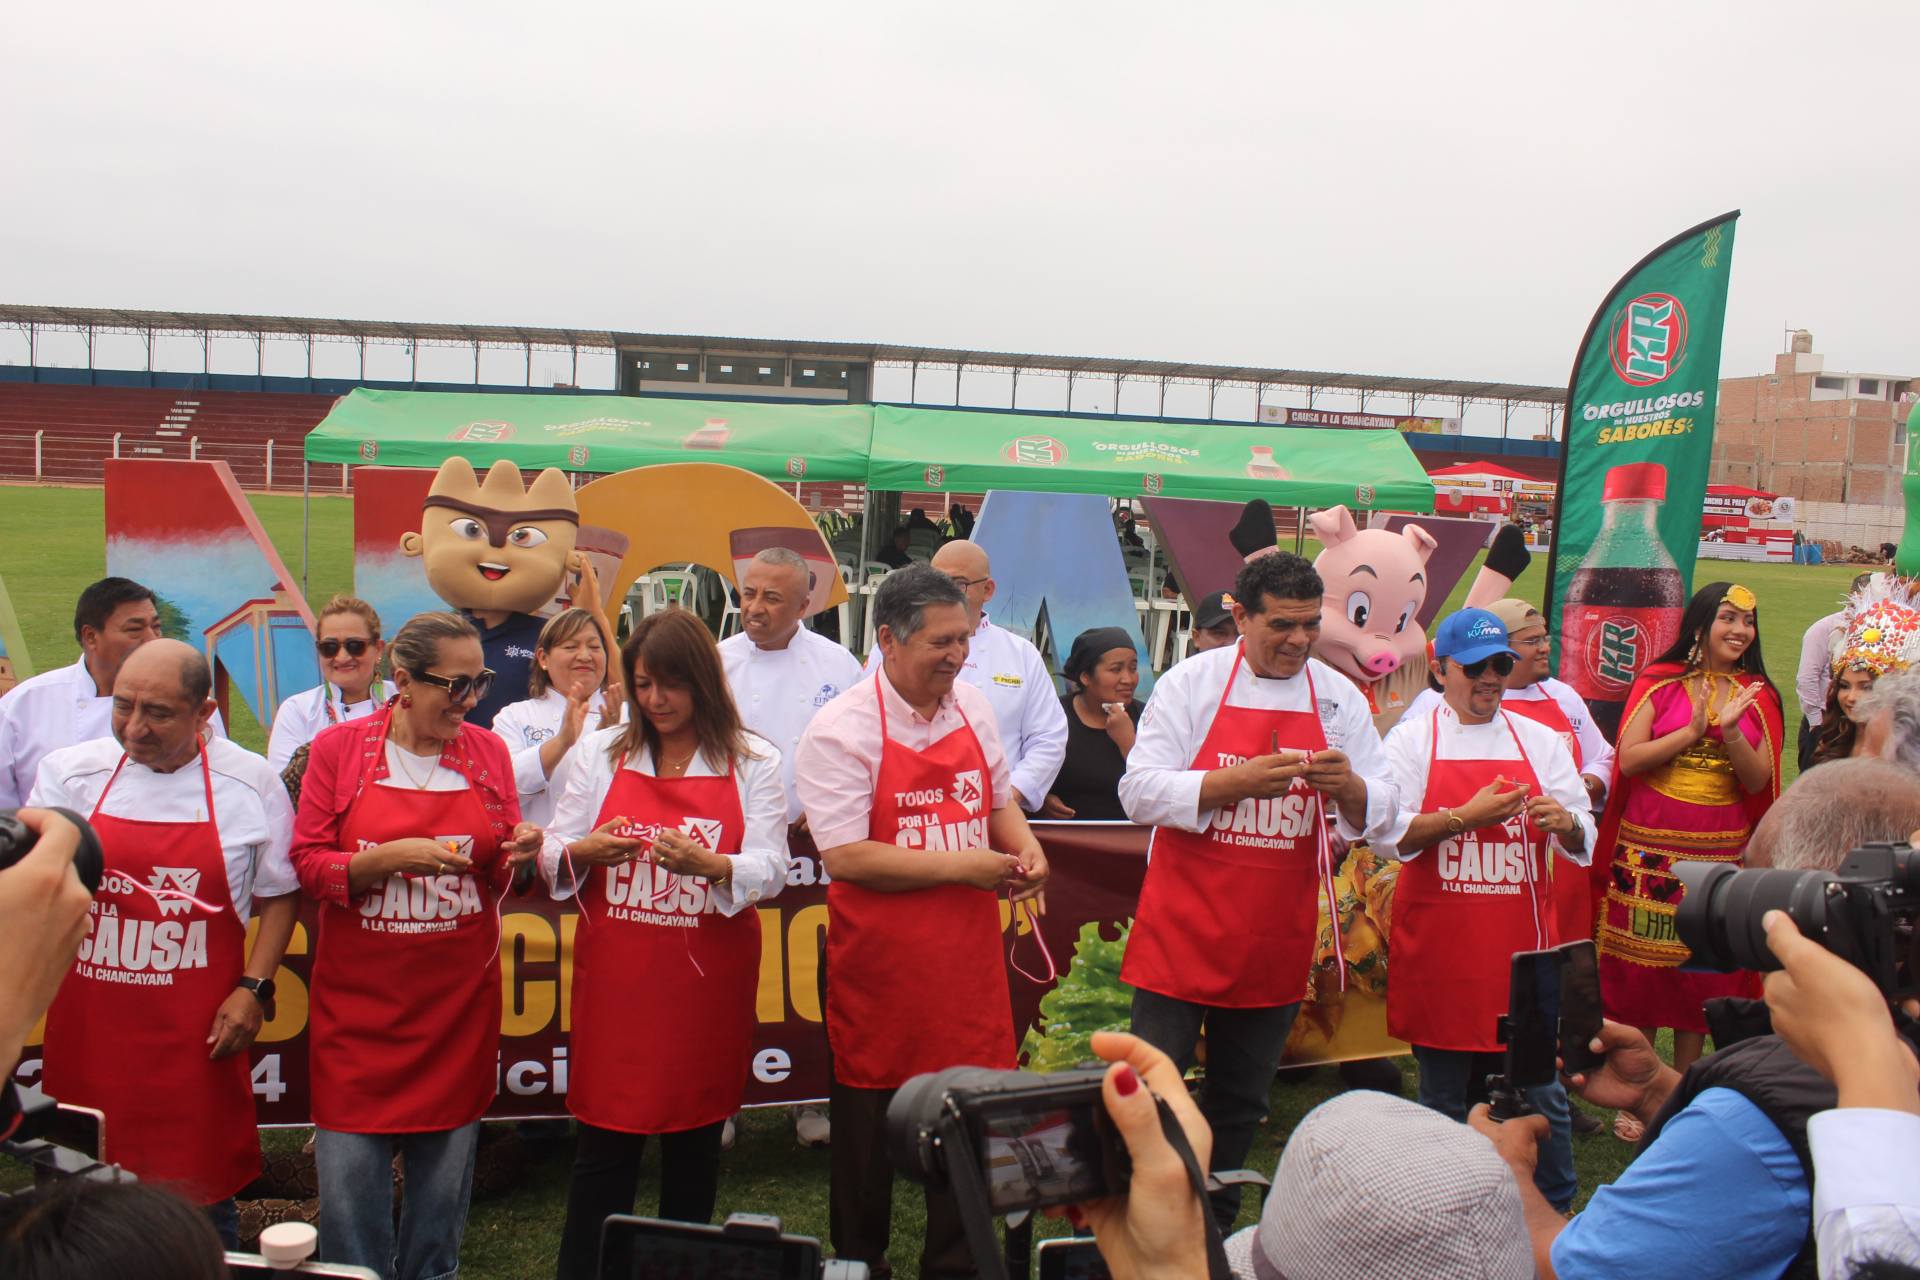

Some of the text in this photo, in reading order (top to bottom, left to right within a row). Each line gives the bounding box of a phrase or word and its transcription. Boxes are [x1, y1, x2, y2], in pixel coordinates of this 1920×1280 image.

[1626, 300, 1674, 380] KR
[1583, 391, 1704, 420] ORGULLOSOS
[1291, 411, 1396, 428] CAUSA A LA CHANCAYANA
[1625, 411, 1671, 424] NUESTROS
[1597, 418, 1688, 444] SABORES
[1598, 621, 1638, 684] KR
[1218, 753, 1248, 768] TOD
[895, 788, 944, 807] TODOS
[898, 813, 940, 829] POR LA
[1212, 794, 1316, 838] CAUSA
[1213, 831, 1295, 849] A LA CHANCAYANA
[1442, 881, 1521, 895] A LA CHANCAYANA
[102, 901, 118, 917] LA
[607, 906, 699, 928] A LA CHANCAYANA
[362, 919, 457, 934] A LA CHANCAYANA
[77, 913, 208, 971] CAUSA
[76, 963, 174, 985] A LA CHANCAYANA
